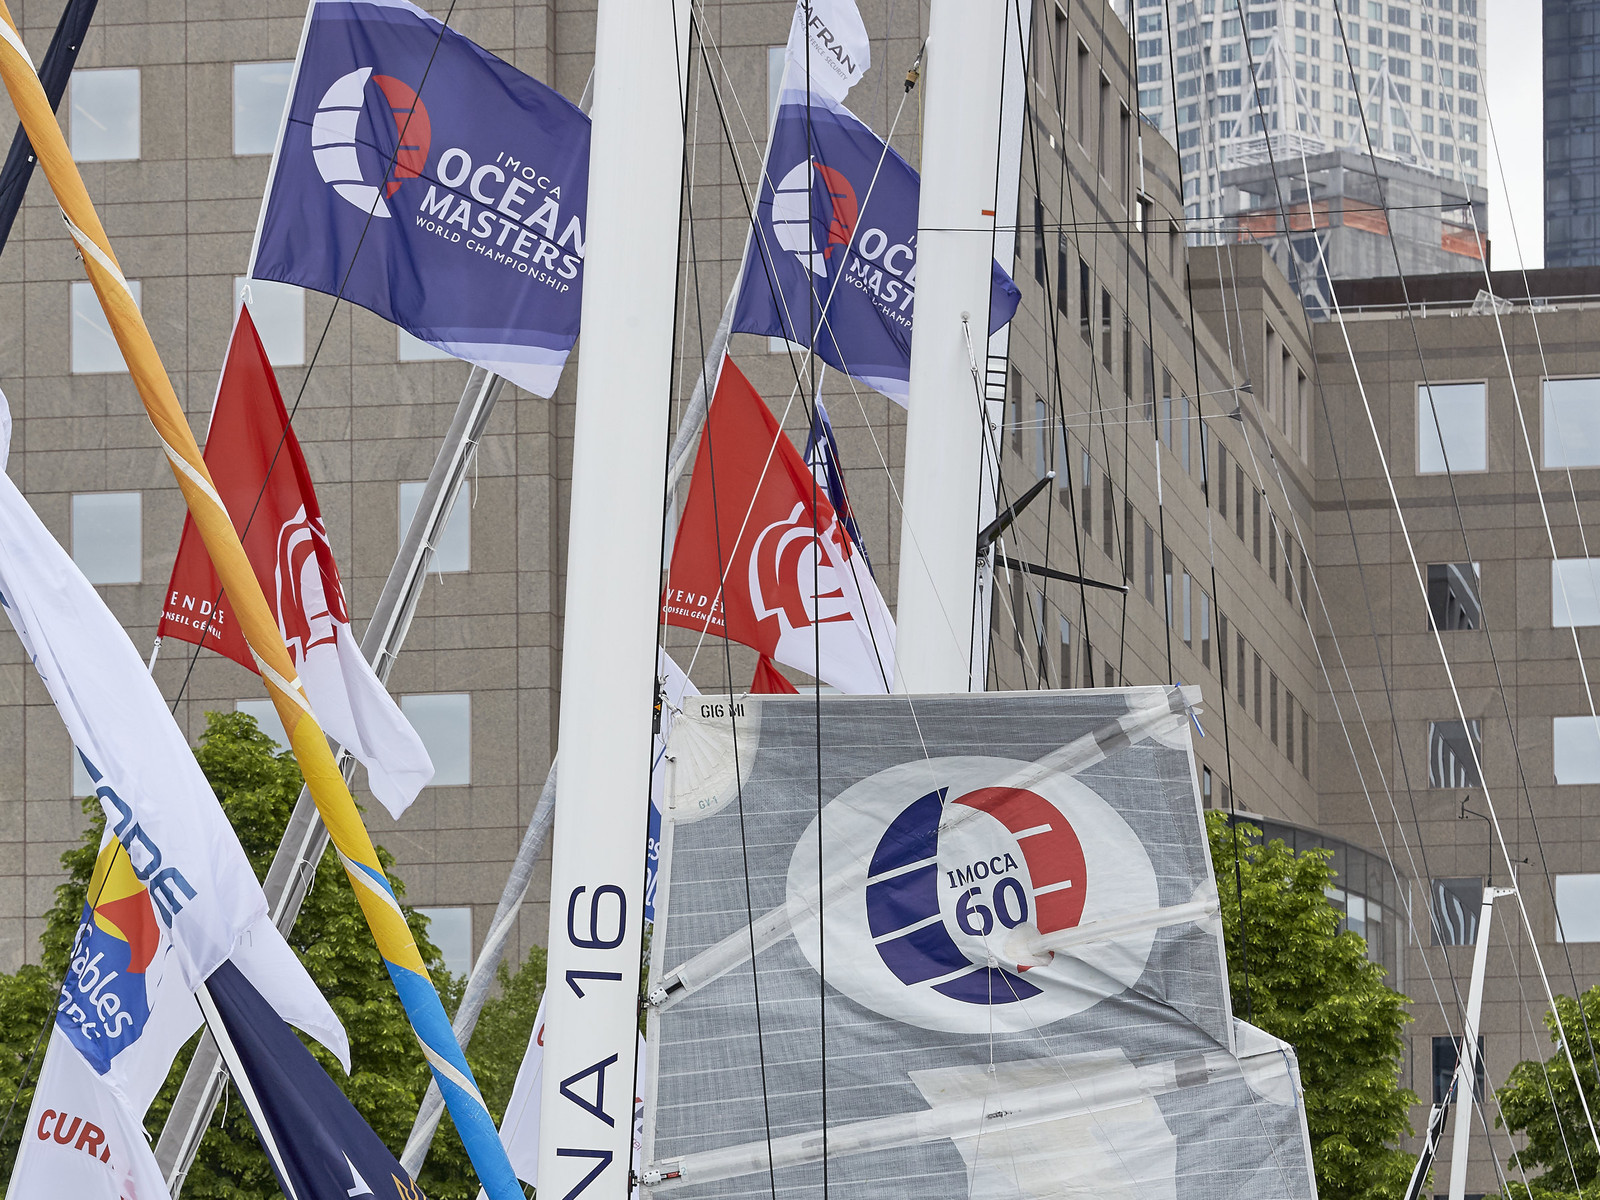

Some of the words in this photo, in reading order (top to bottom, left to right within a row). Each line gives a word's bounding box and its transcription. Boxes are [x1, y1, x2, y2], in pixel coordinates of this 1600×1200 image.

[825, 56, 848, 81] SECURITY
[437, 147, 586, 258] OCEAN
[496, 151, 561, 199] IMOCA
[416, 215, 461, 243] WORLD
[466, 239, 570, 293] CHAMPIONSHIP
[419, 184, 581, 280] MASTERS
[946, 853, 1018, 889] IMOCA
[956, 876, 1029, 936] 60
[565, 884, 628, 1000] 16
